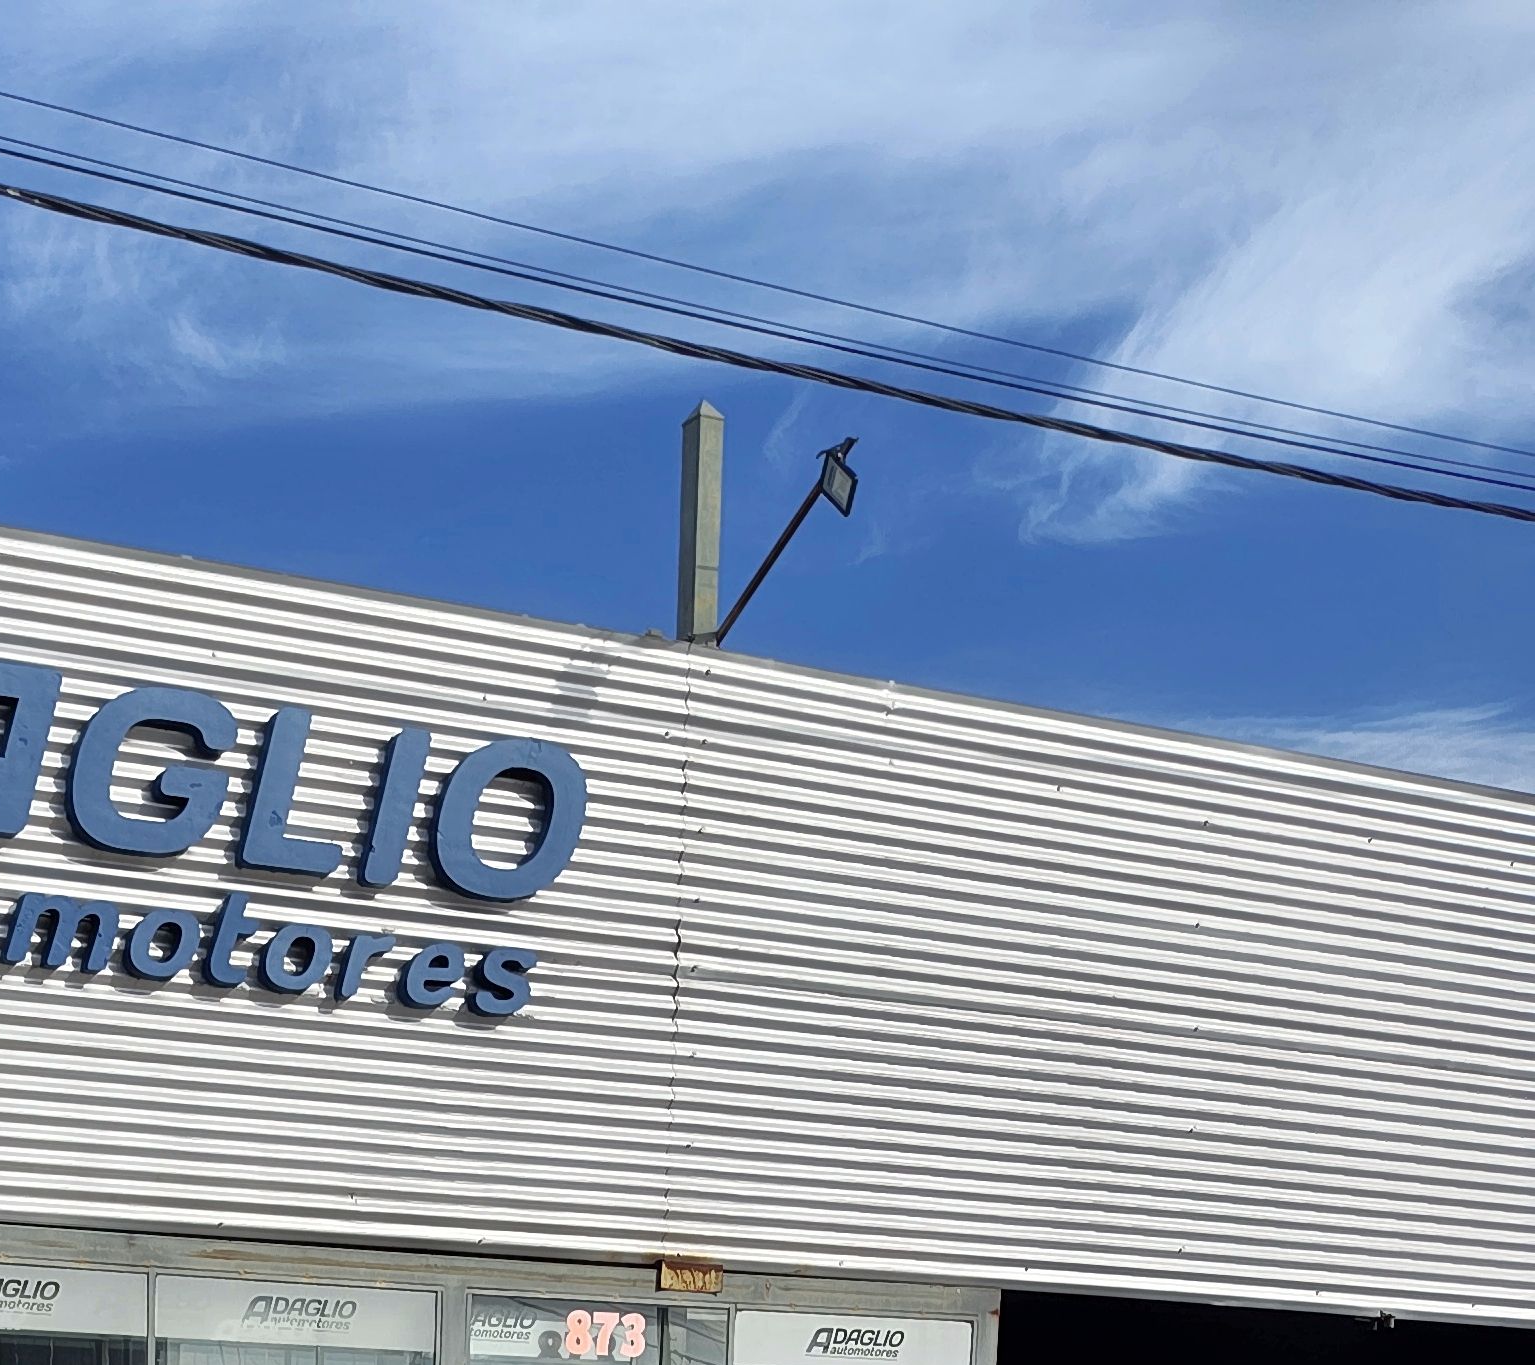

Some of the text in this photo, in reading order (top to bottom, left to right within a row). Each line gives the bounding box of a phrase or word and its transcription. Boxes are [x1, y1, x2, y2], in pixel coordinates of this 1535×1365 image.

[241, 1295, 357, 1327] ADAGLIO
[565, 1309, 646, 1358] 873
[806, 1327, 904, 1354] ADAGLIO
[830, 1346, 899, 1358] automotores
